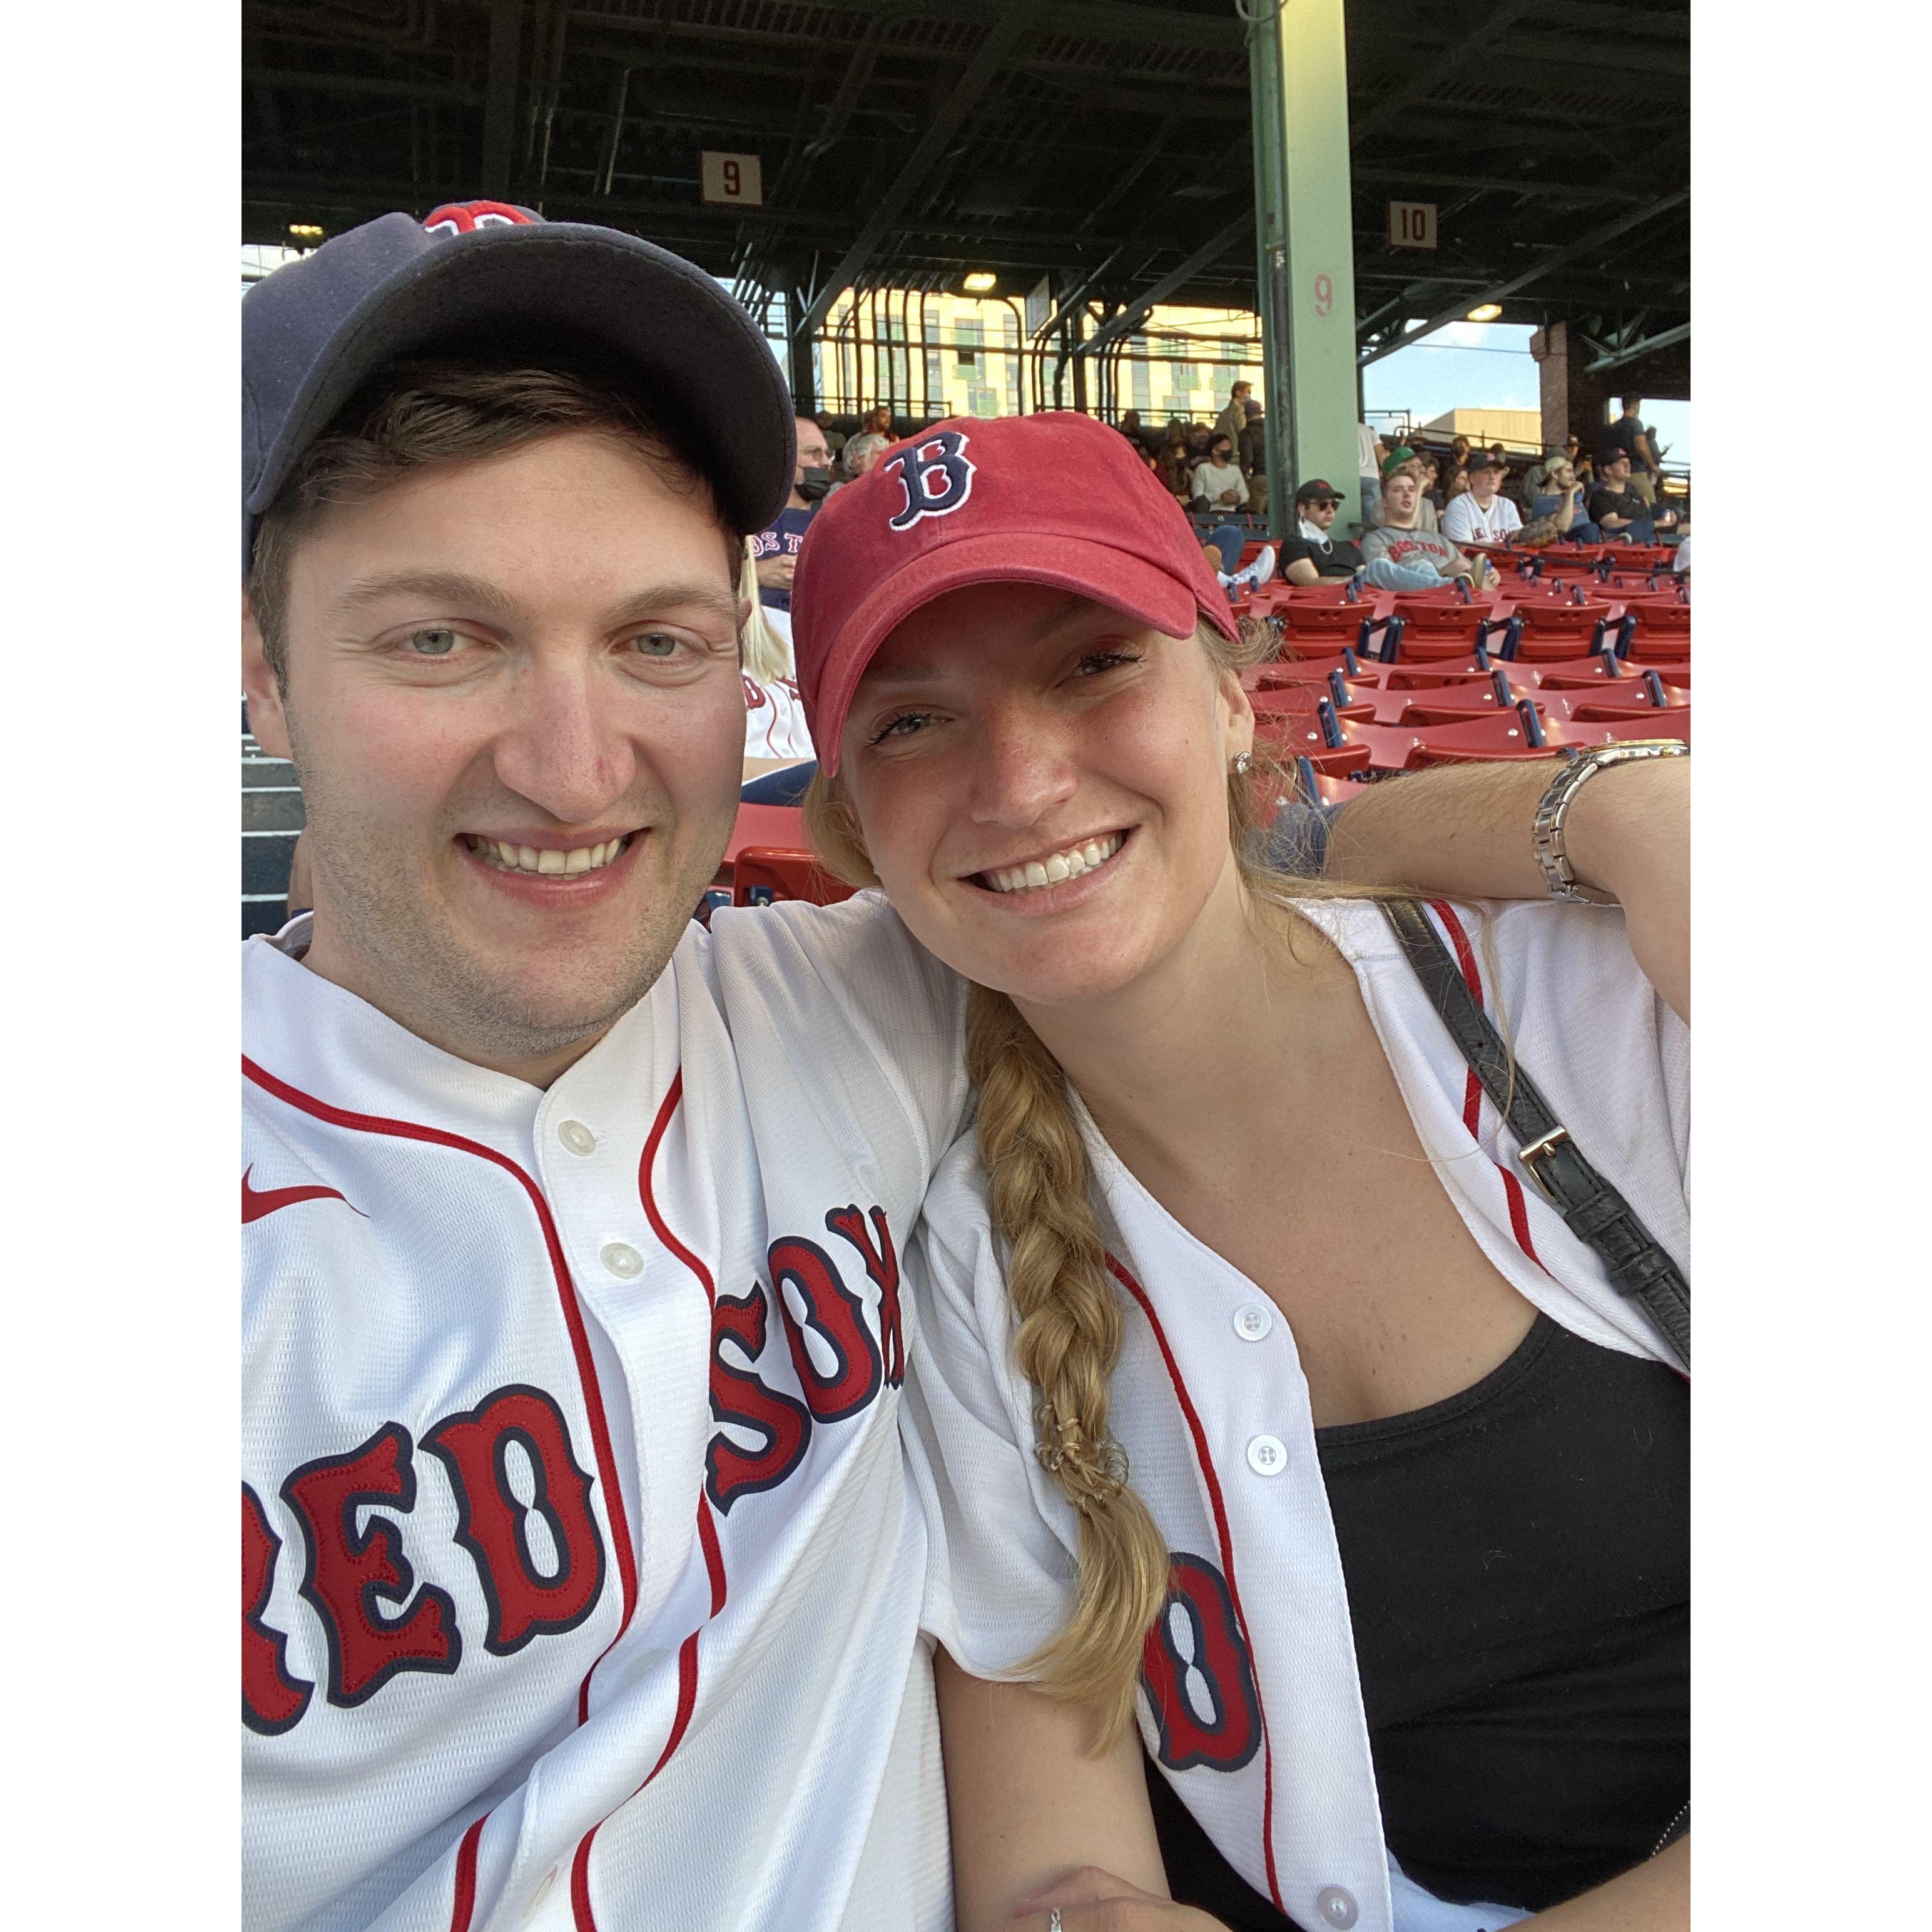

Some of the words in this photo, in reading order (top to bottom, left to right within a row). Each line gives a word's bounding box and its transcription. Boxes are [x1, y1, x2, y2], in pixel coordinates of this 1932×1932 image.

[724, 160, 740, 195] 9
[1401, 208, 1426, 241] 10
[1315, 273, 1332, 317] 9
[884, 432, 977, 531] B
[706, 1204, 905, 1517] SOX
